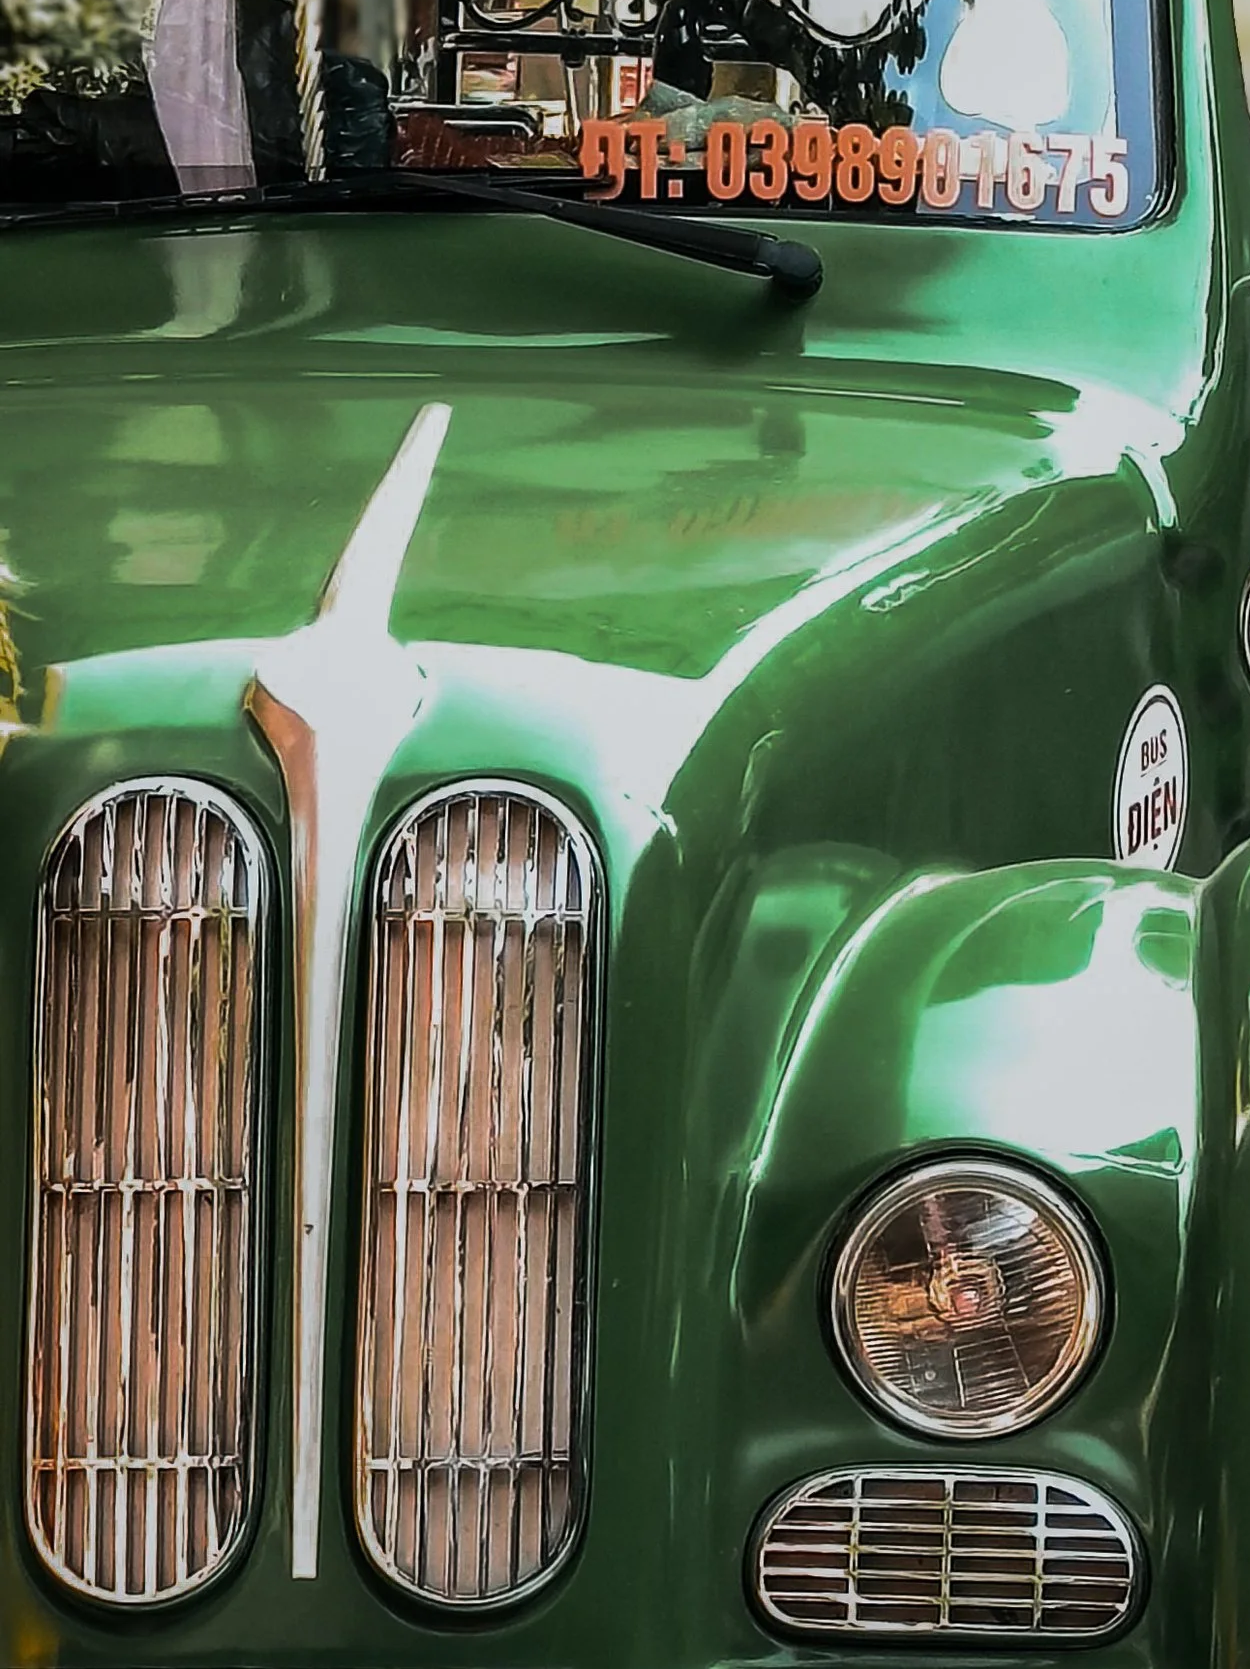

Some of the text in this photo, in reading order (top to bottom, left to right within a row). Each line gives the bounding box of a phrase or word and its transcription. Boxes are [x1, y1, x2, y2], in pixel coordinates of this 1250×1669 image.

[706, 118, 1130, 217] 0398901675
[1140, 728, 1168, 772] BUS
[1127, 776, 1177, 857] ĐIỆN
